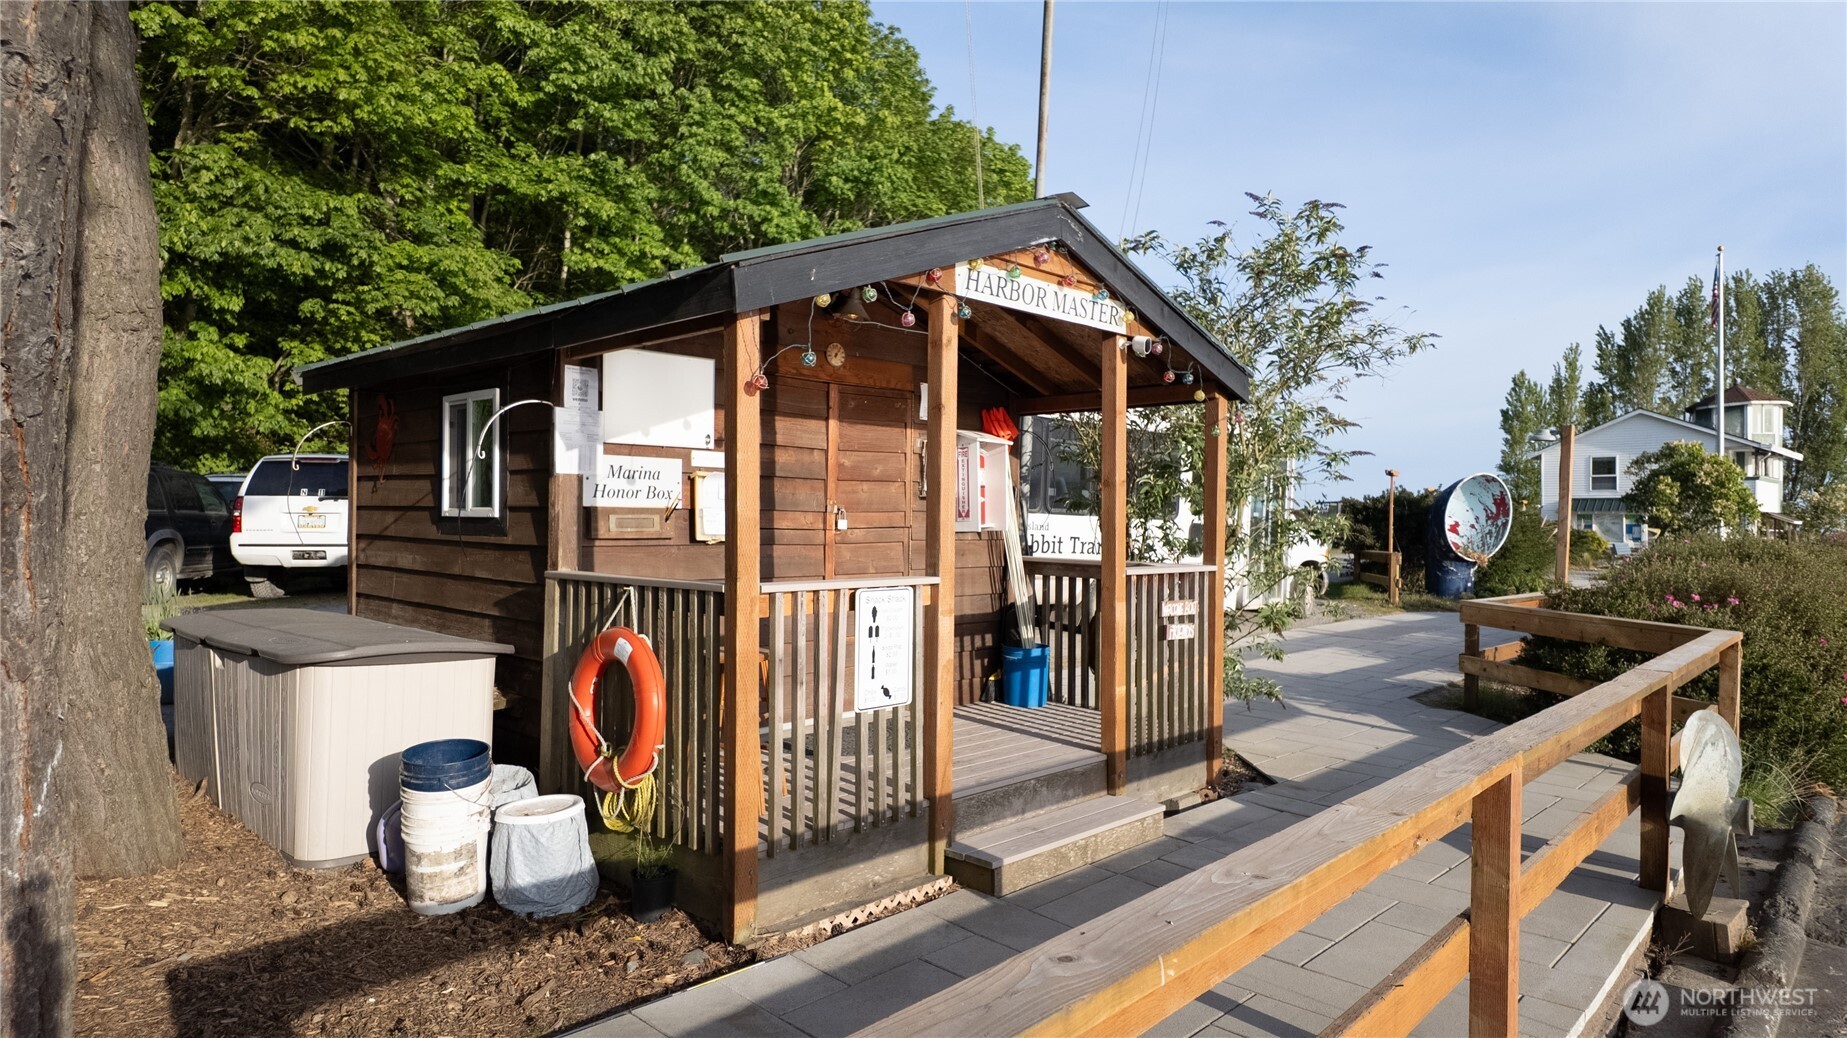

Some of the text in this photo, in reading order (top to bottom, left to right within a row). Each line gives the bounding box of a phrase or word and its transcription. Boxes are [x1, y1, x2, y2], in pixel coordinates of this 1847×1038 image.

[965, 267, 1119, 326] HARBOR MASTER
[607, 464, 661, 480] Marina
[592, 483, 673, 500] Honor Box
[1027, 521, 1050, 531] sland
